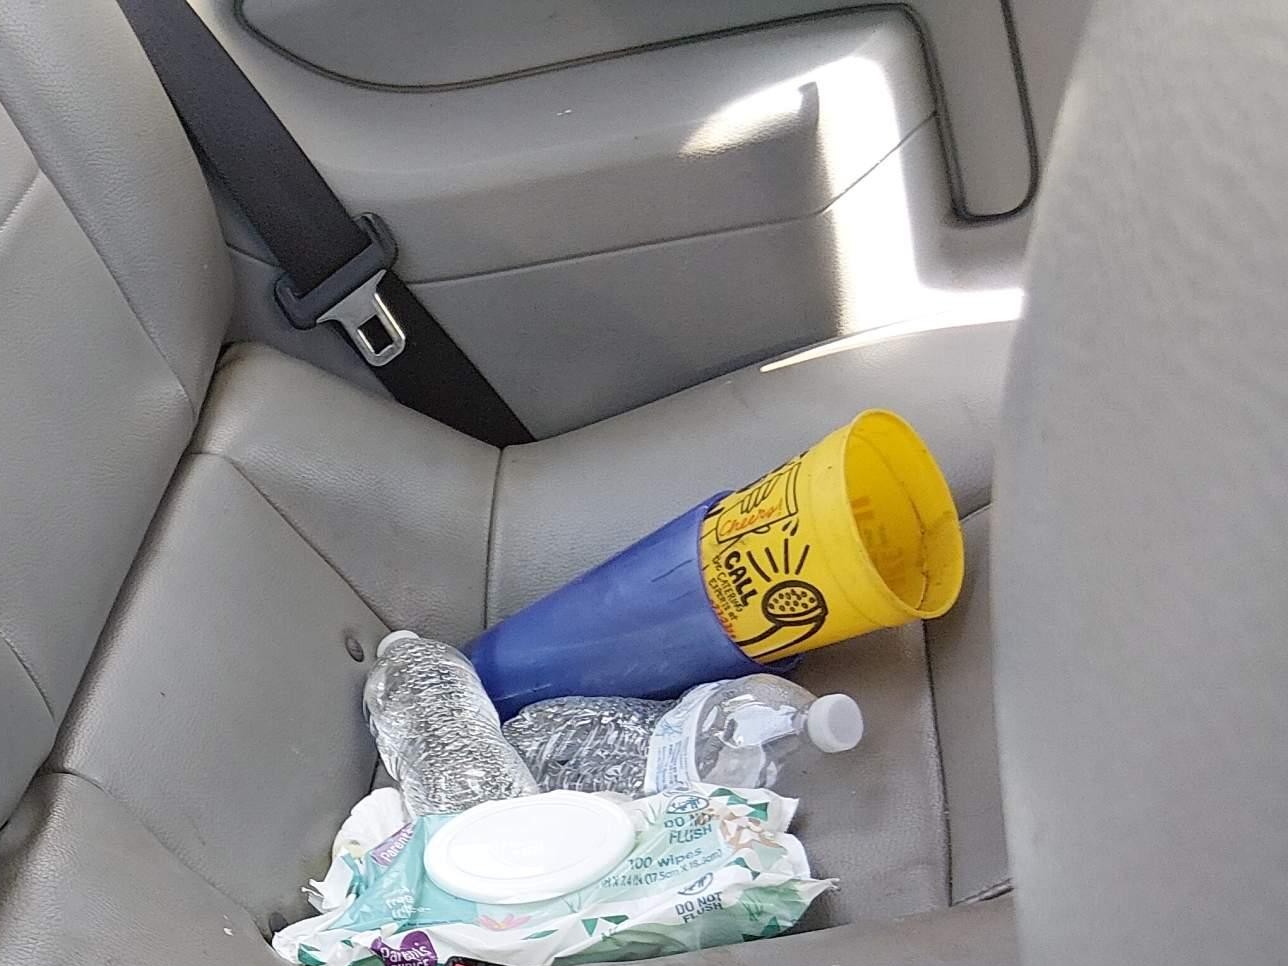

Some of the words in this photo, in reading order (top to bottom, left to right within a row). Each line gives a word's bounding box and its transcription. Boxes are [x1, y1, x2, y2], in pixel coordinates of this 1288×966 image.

[724, 550, 758, 607] CALL
[717, 571, 744, 612] CATERING
[663, 816, 685, 828] DO
[669, 823, 712, 844] FLUSH
[629, 856, 653, 870] 100
[657, 847, 703, 866] wipes
[675, 900, 695, 916] DO
[696, 891, 723, 907] NOT
[682, 902, 724, 924] FLUSH
